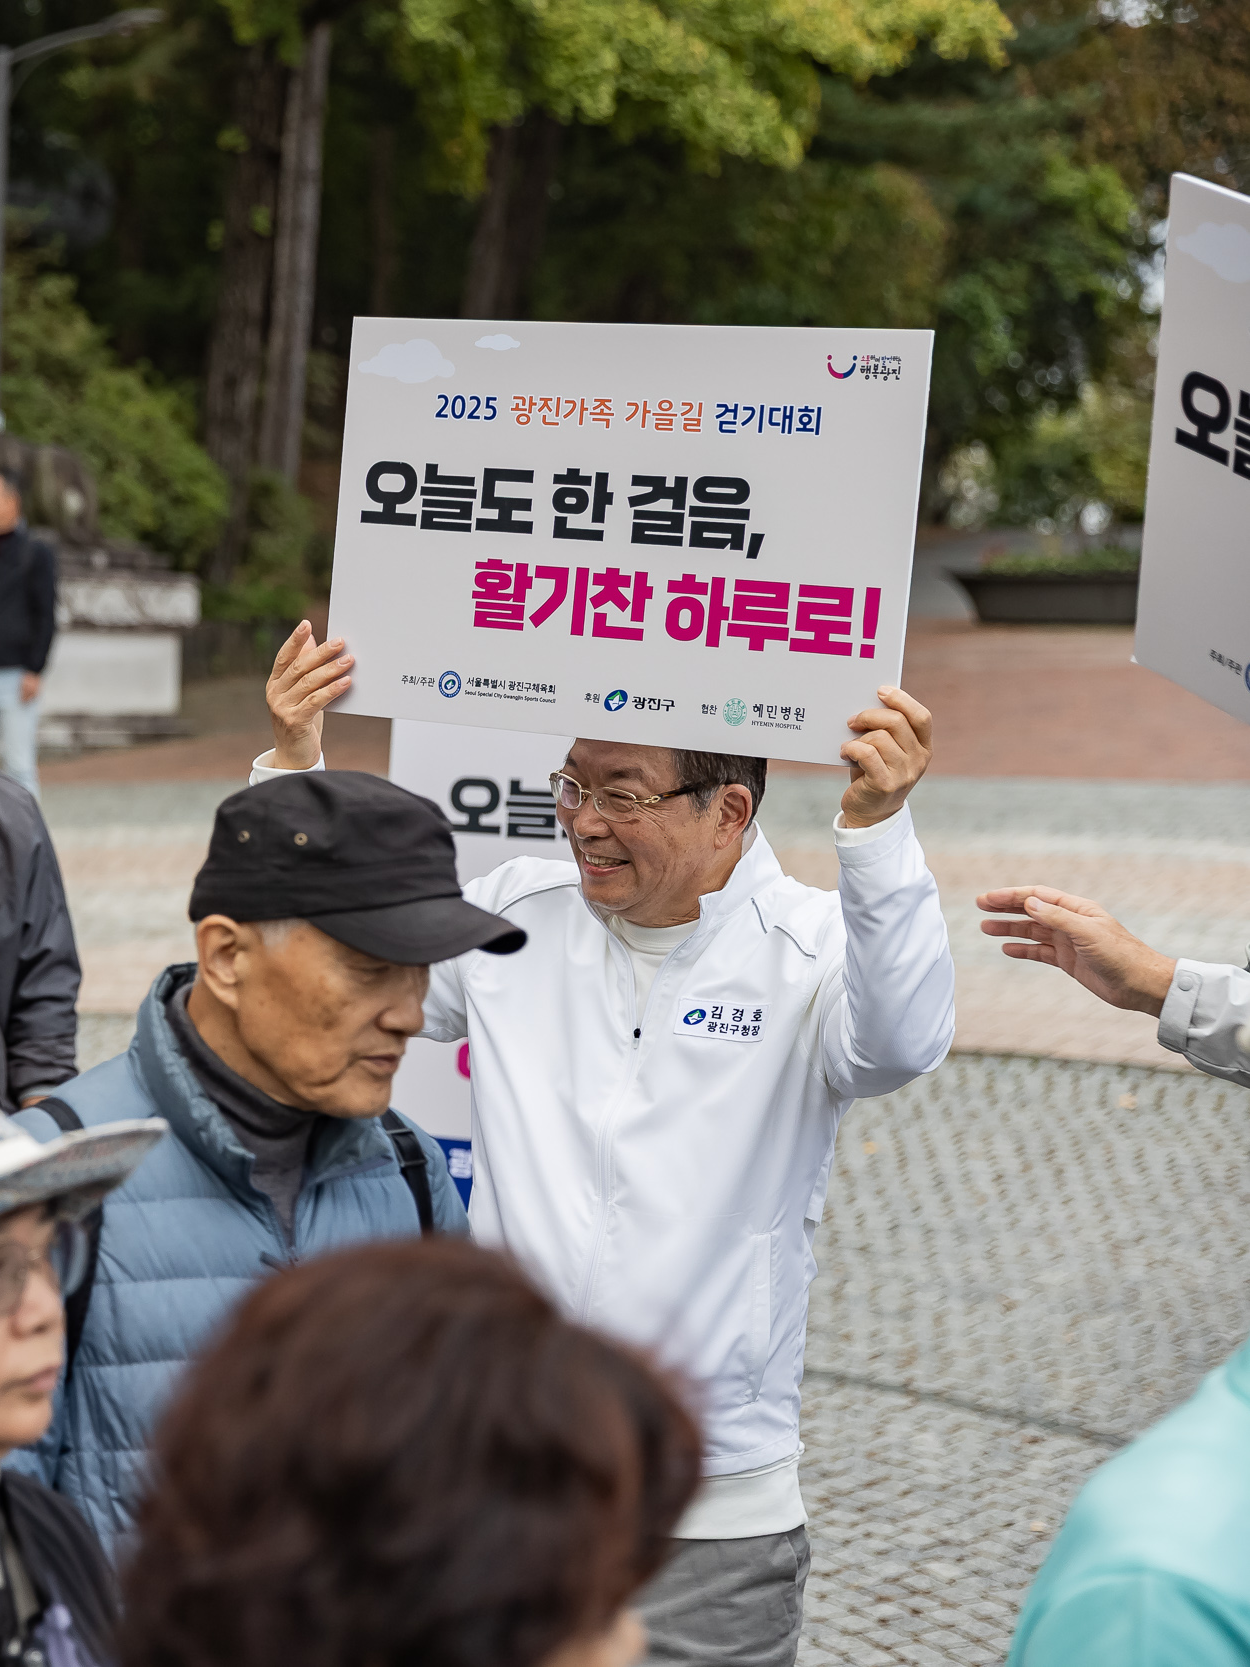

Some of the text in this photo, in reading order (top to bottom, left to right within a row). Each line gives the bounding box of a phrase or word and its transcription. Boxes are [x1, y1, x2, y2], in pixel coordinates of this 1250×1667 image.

[860, 363, 901, 381] 행복광진
[434, 393, 824, 436] 2025 광진가족 가을길 걷기대회
[359, 460, 766, 560] 오늘도 한 걸음,
[470, 557, 883, 660] 활기찬 하루로!
[400, 674, 436, 688] 주최/주관
[466, 676, 506, 690] 서울특별시
[507, 680, 557, 695] 광진구체육회
[477, 690, 493, 698] Special
[493, 692, 503, 700] City
[503, 693, 524, 701] Gwangjin
[524, 695, 539, 703] Sports
[539, 696, 557, 704] Council
[584, 692, 601, 704] 후원
[631, 695, 676, 712] 광진구
[700, 703, 718, 716] 협찬
[752, 703, 806, 723] 혜민병원
[751, 720, 803, 731] HYEMIN HOSPITAL
[451, 778, 568, 839] 오늘
[707, 1021, 760, 1036] 광진구청장
